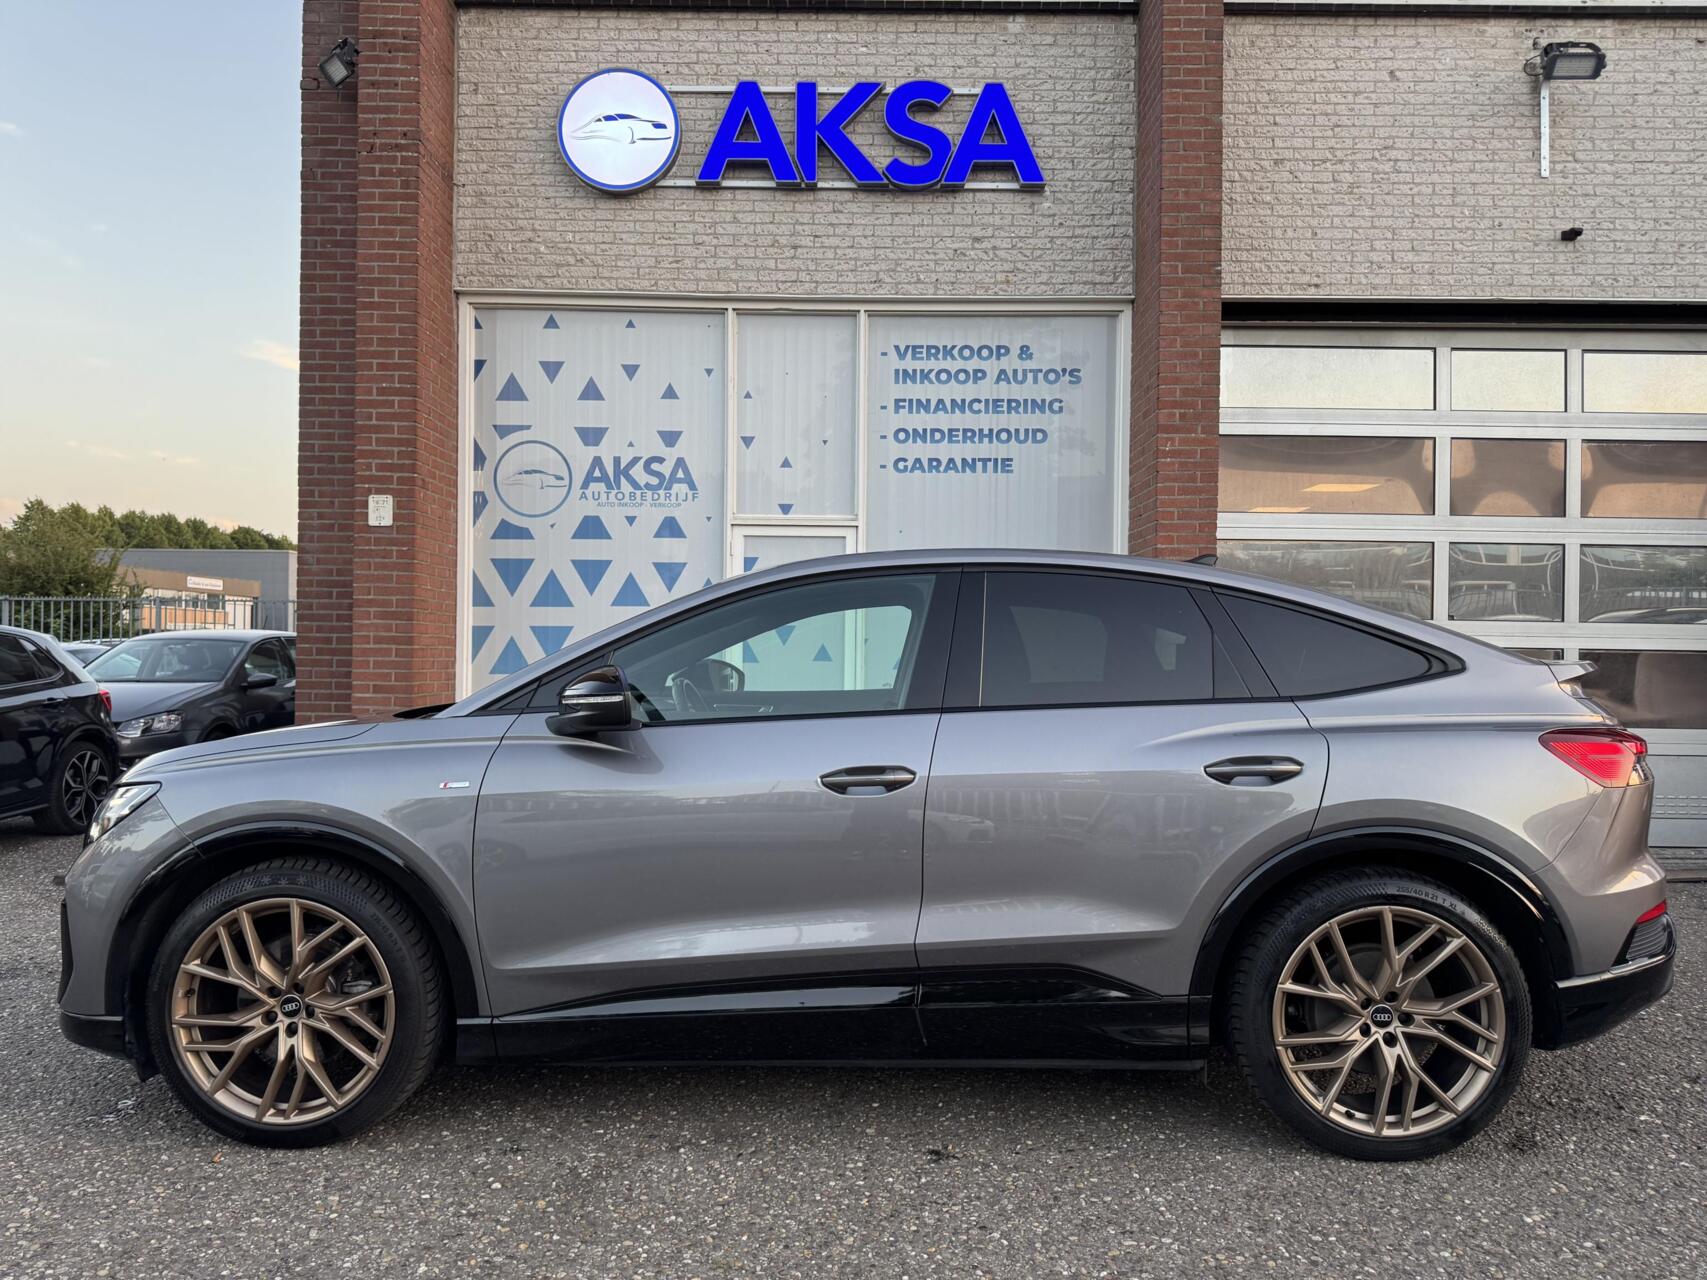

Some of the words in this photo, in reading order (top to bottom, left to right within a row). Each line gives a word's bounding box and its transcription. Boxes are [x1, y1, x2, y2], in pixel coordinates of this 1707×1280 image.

[696, 80, 1046, 191] AKSA
[893, 344, 1011, 362] VERKOOP
[1017, 344, 1034, 362] &
[893, 368, 988, 386] INKOOP
[993, 367, 1083, 386] AUTO'S
[893, 398, 1064, 415] FINANCIERING
[893, 427, 1049, 445] ONDERHOUD
[580, 456, 698, 491] AKSA
[892, 457, 1014, 474] GARANTIE
[578, 491, 700, 502] AUTOBEDRIJF
